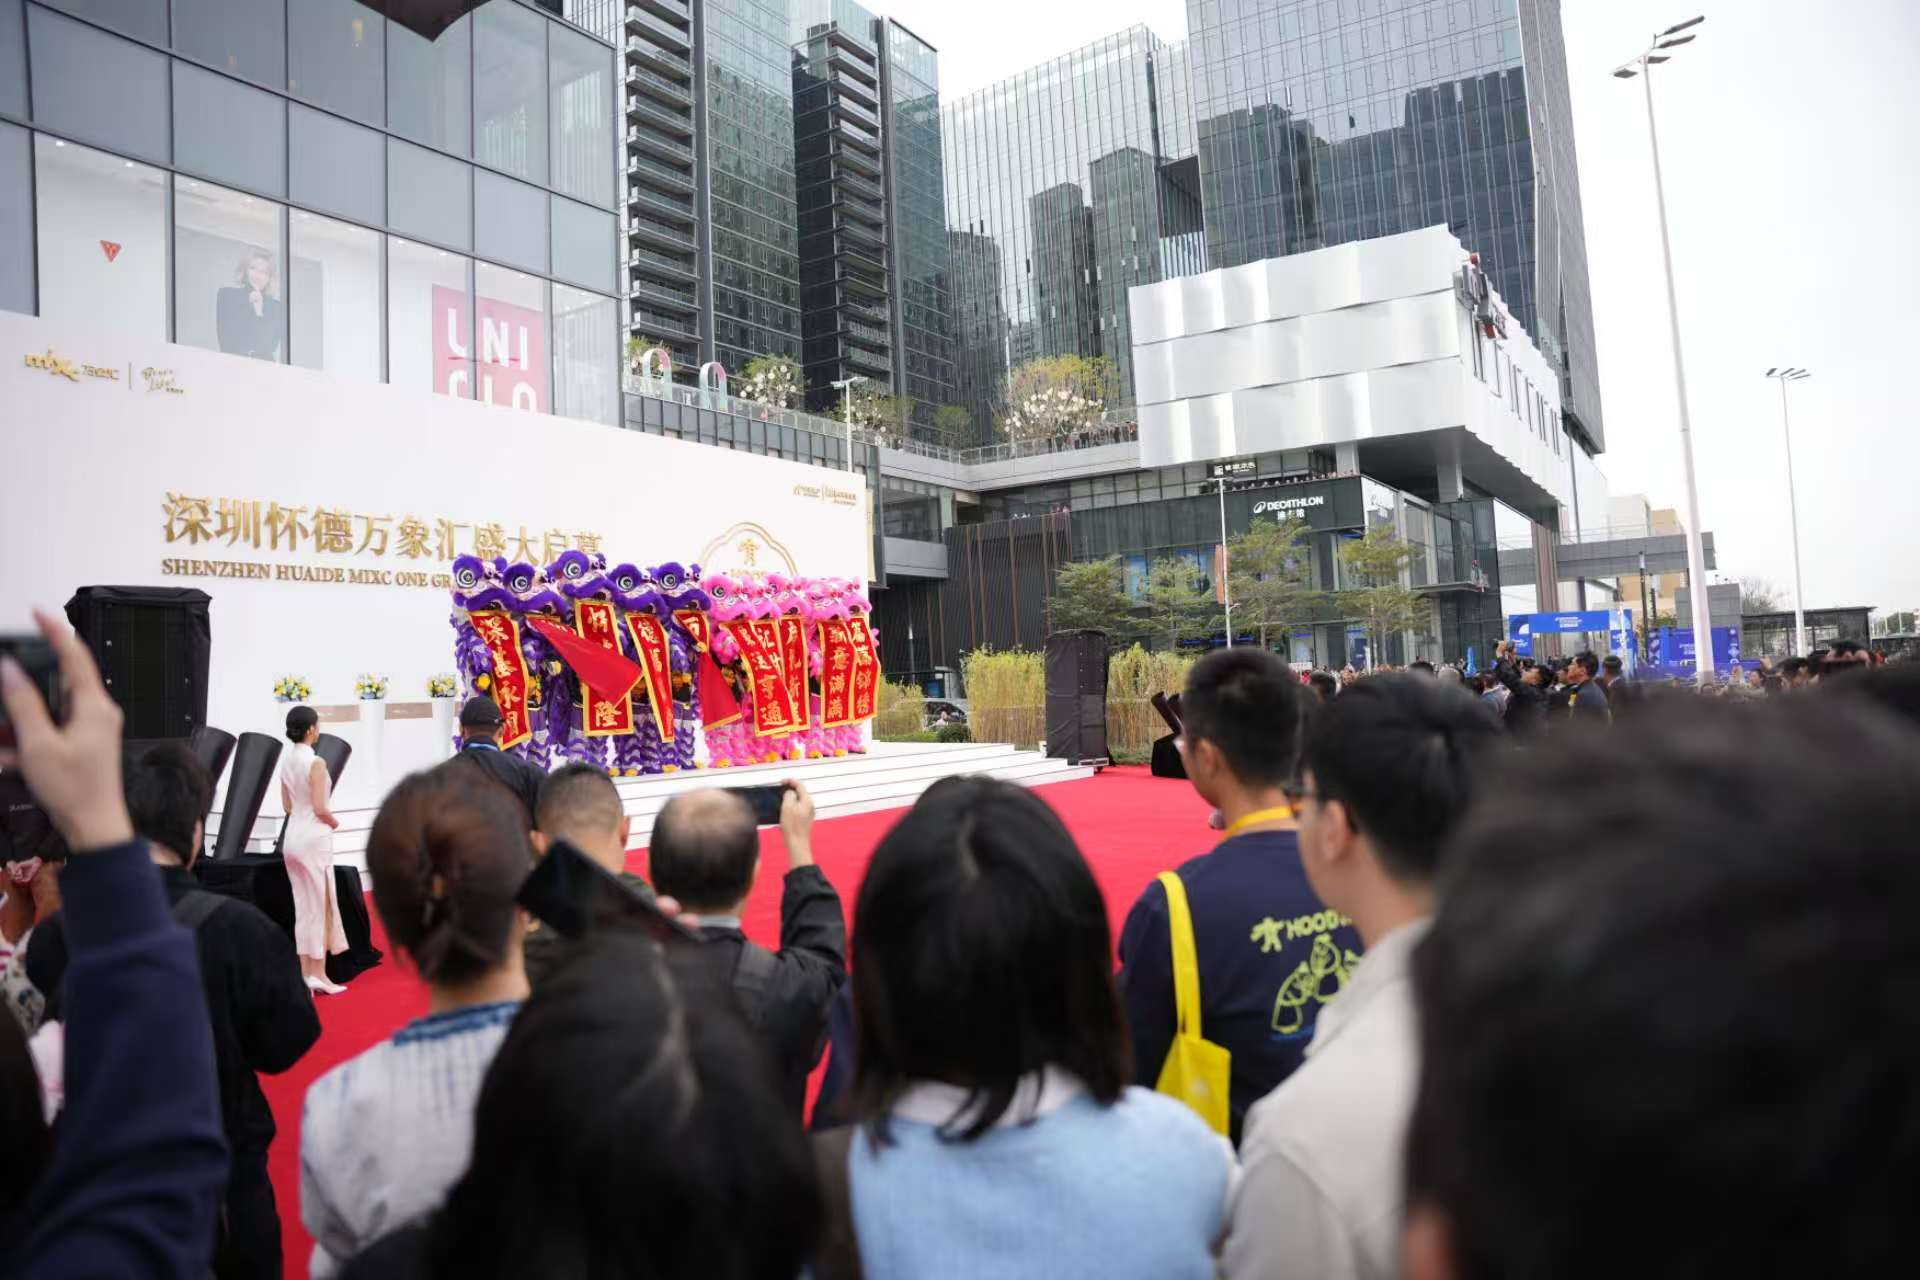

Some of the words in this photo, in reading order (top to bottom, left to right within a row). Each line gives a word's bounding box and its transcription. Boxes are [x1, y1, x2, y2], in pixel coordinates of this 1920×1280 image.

[1267, 496, 1324, 511] DECATHLON
[161, 558, 271, 580] SHENZHEN
[276, 563, 345, 583] HUAIDE
[348, 567, 392, 585] MIXC
[395, 570, 428, 587] ONE
